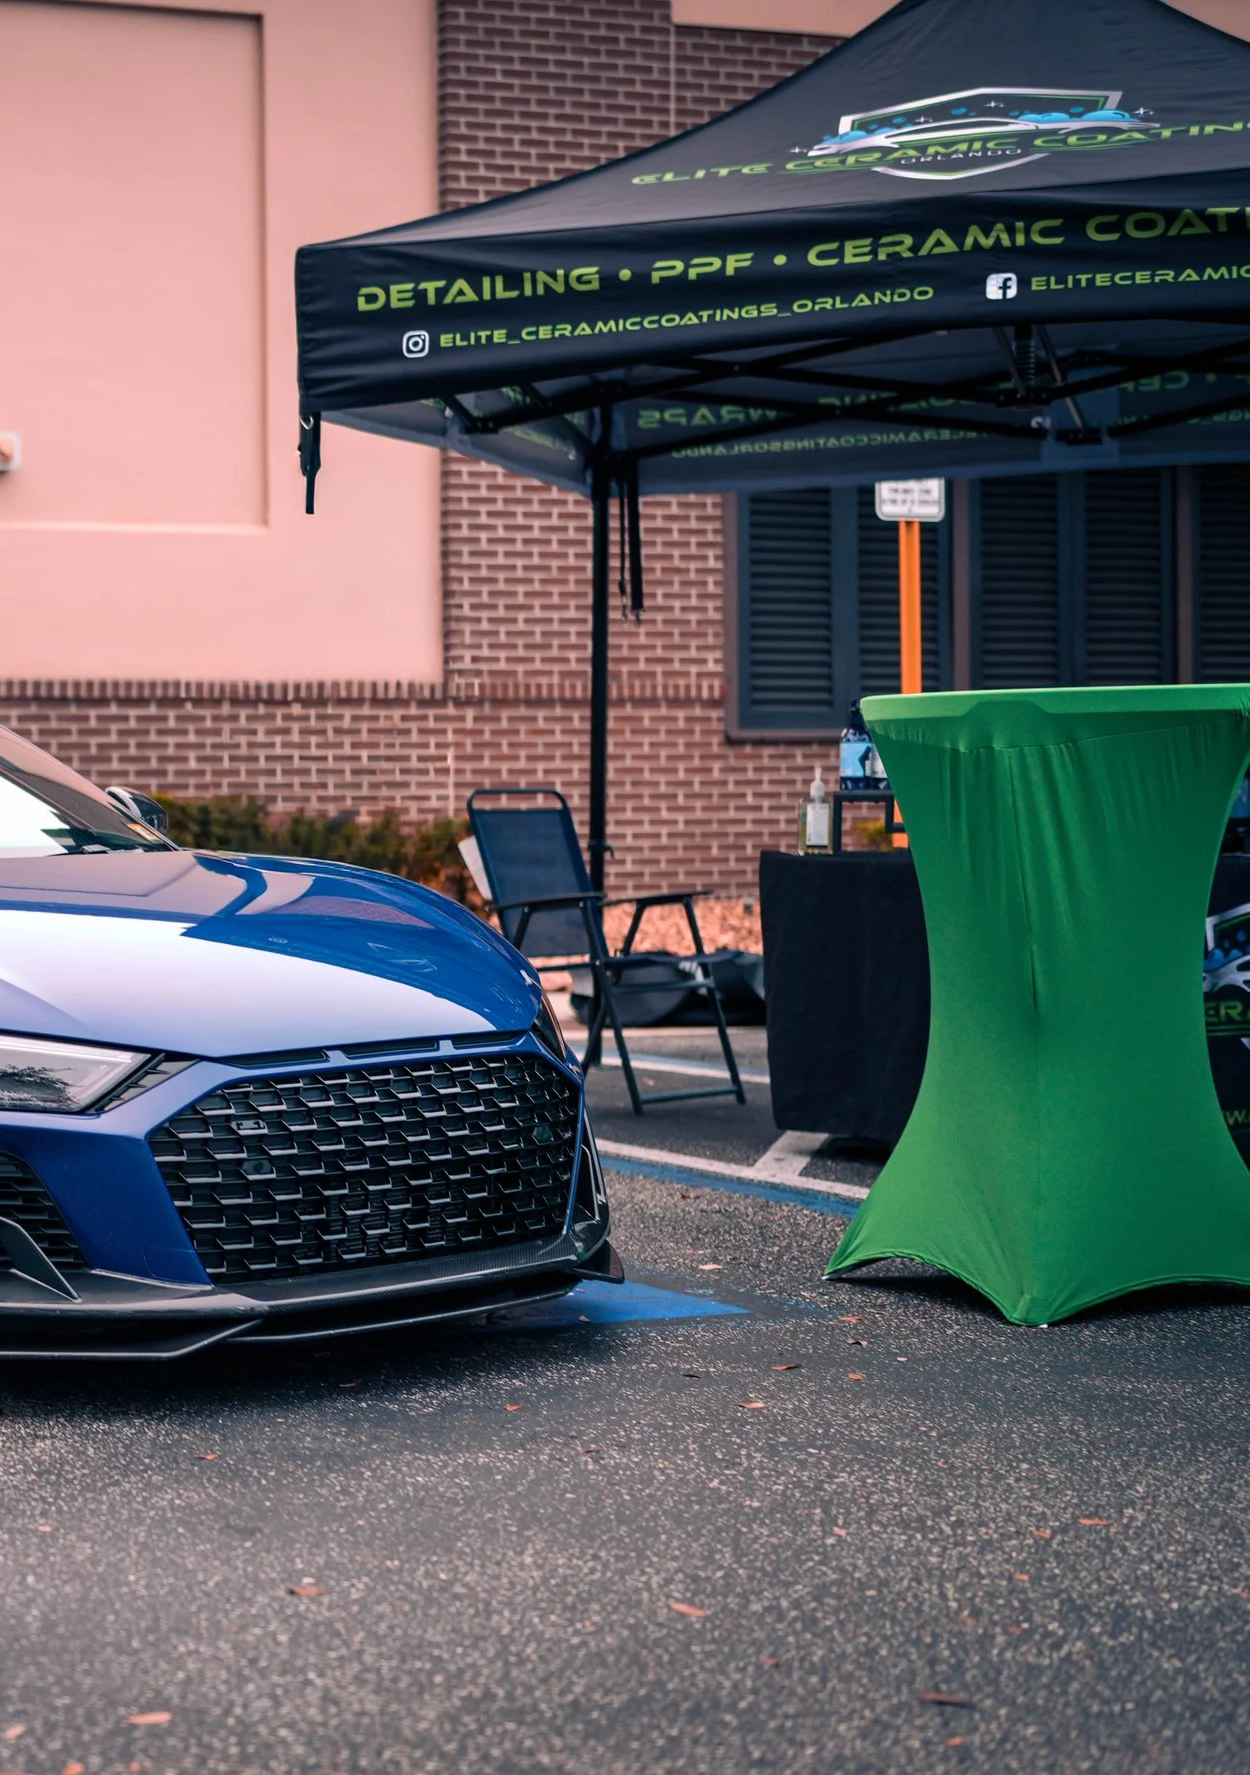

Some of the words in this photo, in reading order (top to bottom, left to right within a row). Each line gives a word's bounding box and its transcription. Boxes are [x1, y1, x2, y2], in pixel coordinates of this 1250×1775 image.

[631, 163, 773, 185] ELITE
[785, 138, 1019, 171] CERAMIC
[1033, 121, 1250, 147] COATIN
[900, 148, 1022, 165] ORLANDO
[357, 266, 600, 312] DETAILING
[651, 252, 754, 285] PPF
[807, 218, 1066, 267] CERAMIC
[439, 286, 935, 348] ELITE_CERAMICCOATINGS_ORLANDO
